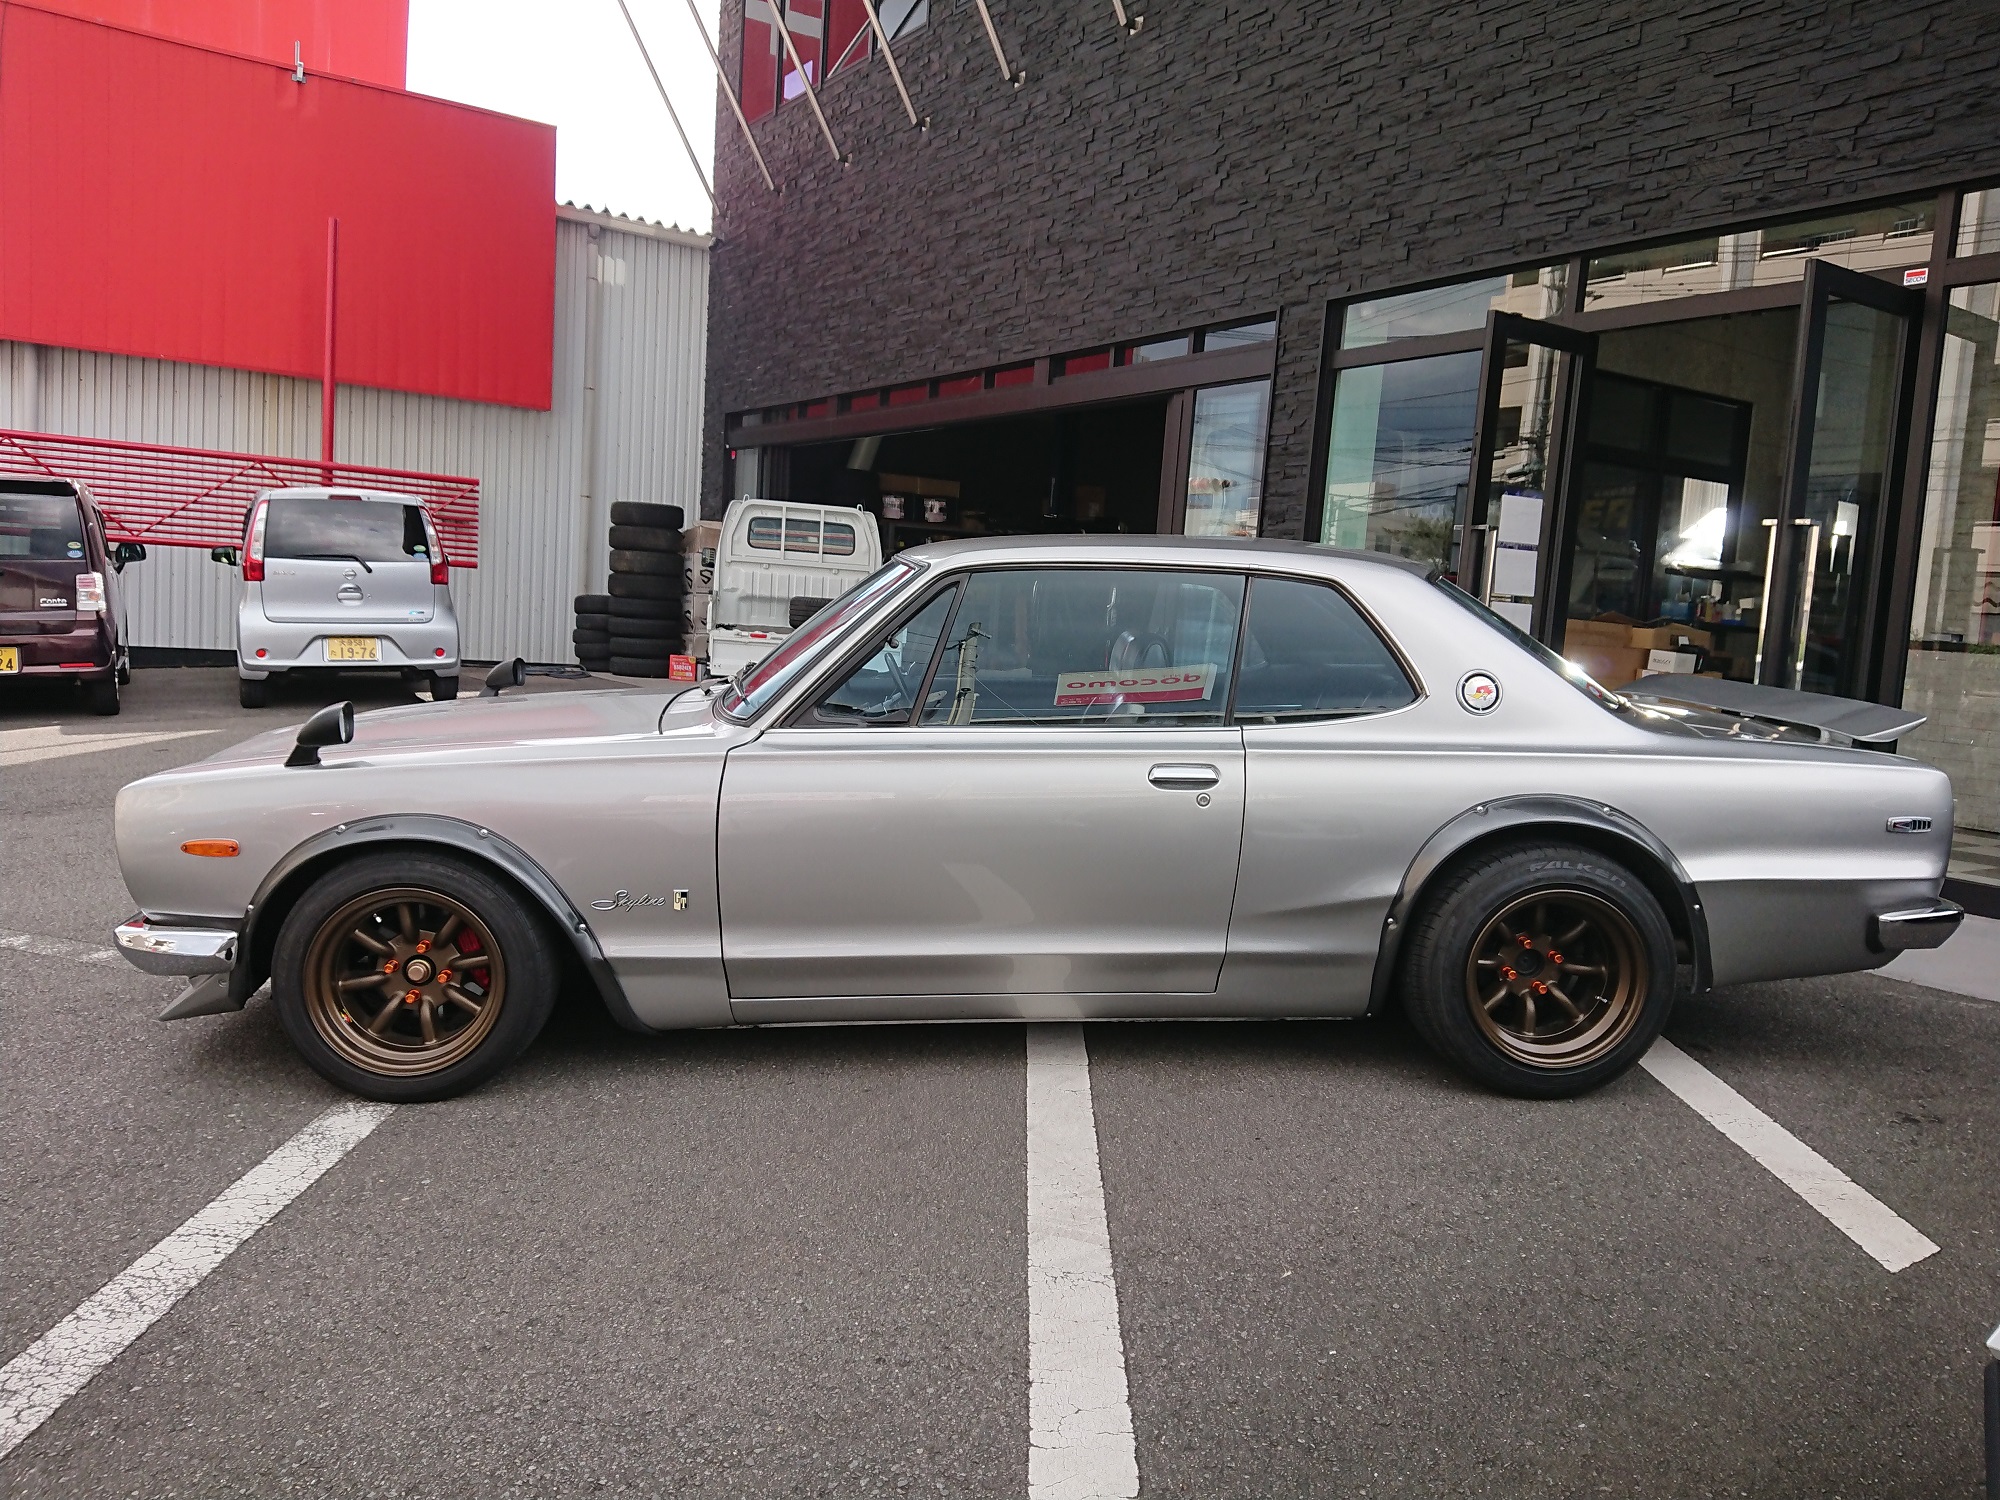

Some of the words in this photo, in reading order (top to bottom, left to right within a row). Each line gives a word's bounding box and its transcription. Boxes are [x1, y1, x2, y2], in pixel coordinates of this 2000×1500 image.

[1905, 276, 1926, 284] SECOM
[340, 647, 376, 659] 19-76
[1527, 860, 1627, 888] FALKEN
[590, 889, 666, 912] Skyline
[674, 891, 688, 909] GT
